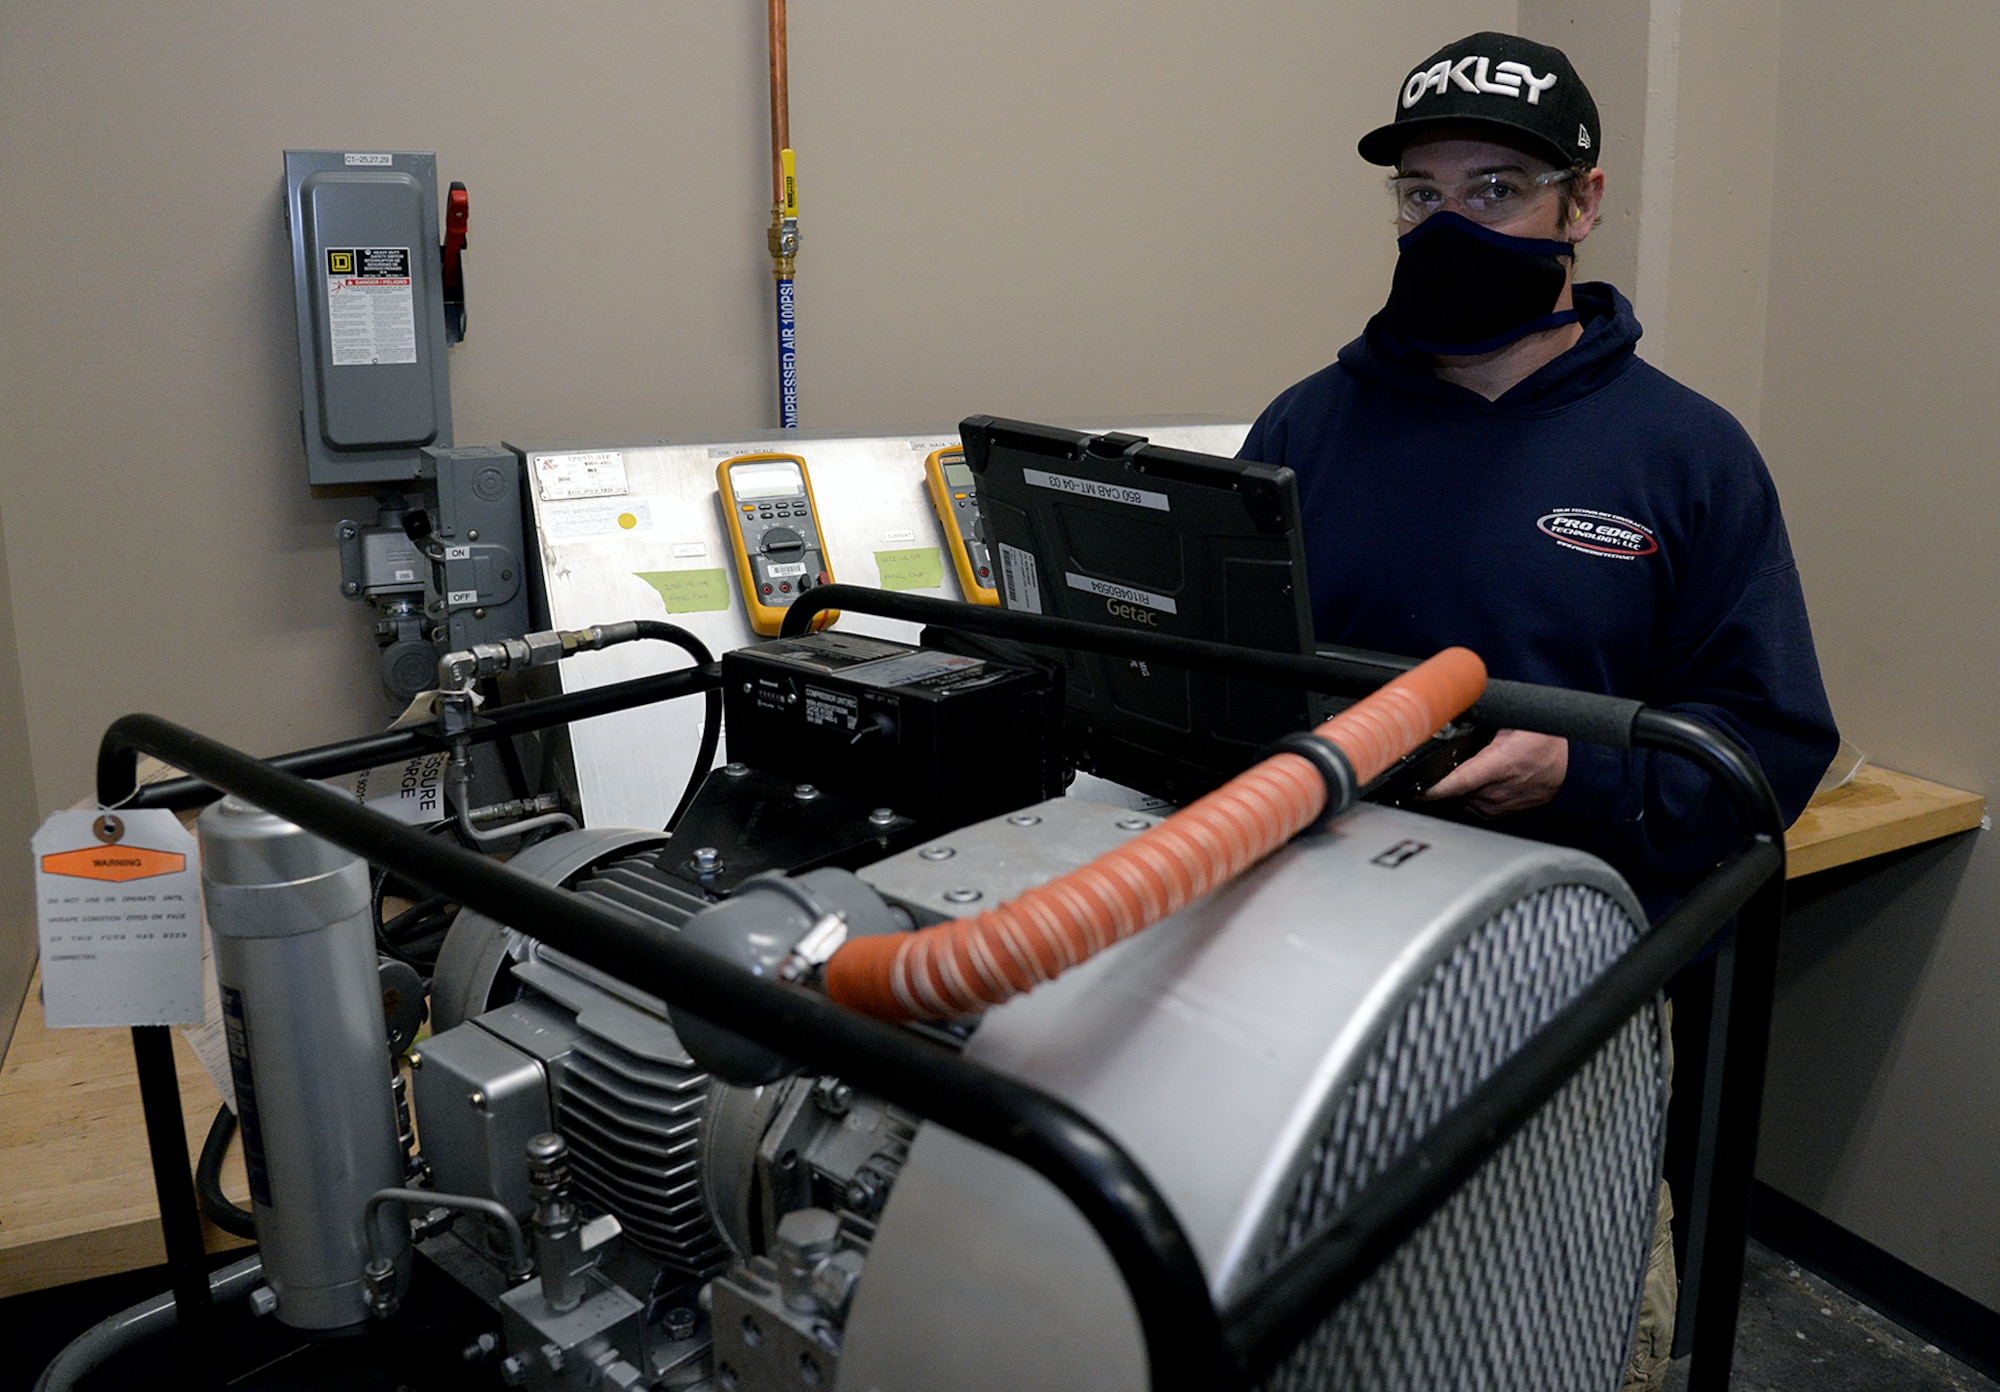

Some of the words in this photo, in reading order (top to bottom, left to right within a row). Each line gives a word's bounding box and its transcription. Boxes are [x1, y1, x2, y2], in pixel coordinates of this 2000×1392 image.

[1402, 56, 1557, 109] OAKLEY
[345, 155, 389, 164] C1-25,27,29
[780, 283, 795, 325] 100PSI
[782, 328, 796, 349] AIR
[1048, 476, 1062, 488] 03
[1062, 479, 1095, 496] MT-04
[1097, 485, 1120, 500] CAB
[1121, 489, 1142, 504] 850
[1552, 516, 1594, 531] PRO
[1595, 525, 1644, 543] EDGE
[452, 549, 465, 558] ON
[1622, 541, 1641, 551] LLC
[453, 593, 471, 602] OFF
[1106, 598, 1159, 627] Getac
[92, 859, 142, 868] WARNING
[81, 915, 121, 923] CONDITION
